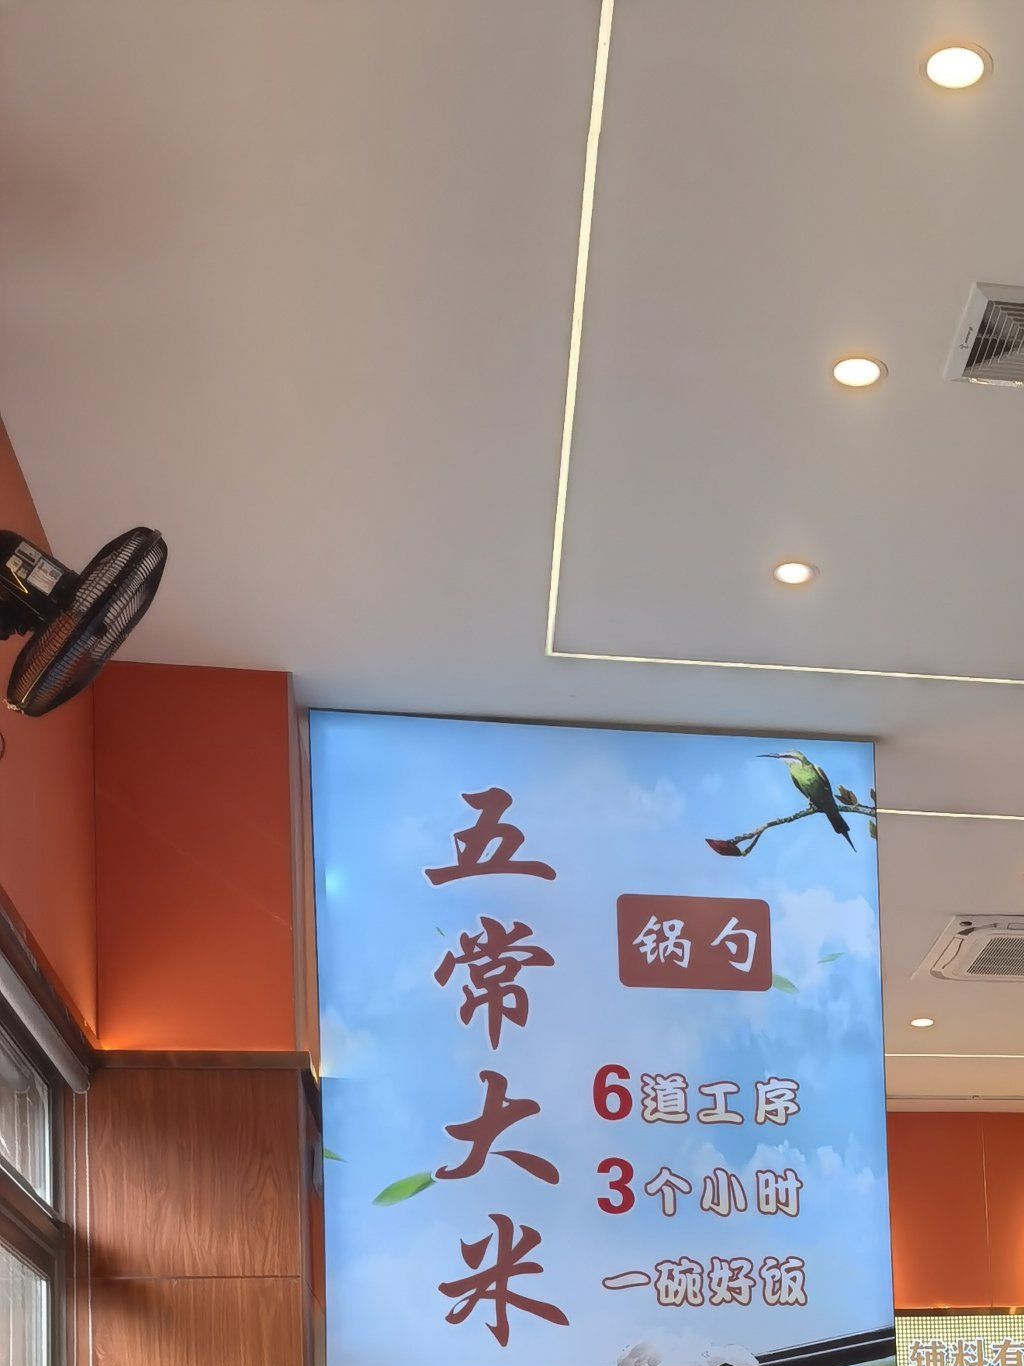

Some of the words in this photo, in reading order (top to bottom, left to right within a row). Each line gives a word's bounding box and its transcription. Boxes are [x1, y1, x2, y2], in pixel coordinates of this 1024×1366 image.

[633, 915, 759, 973] 锅勺
[424, 786, 570, 1347] 五常大米
[592, 1064, 801, 1126] 6道工序
[596, 1156, 803, 1218] 3个小时
[601, 1256, 809, 1308] 一碗好饭
